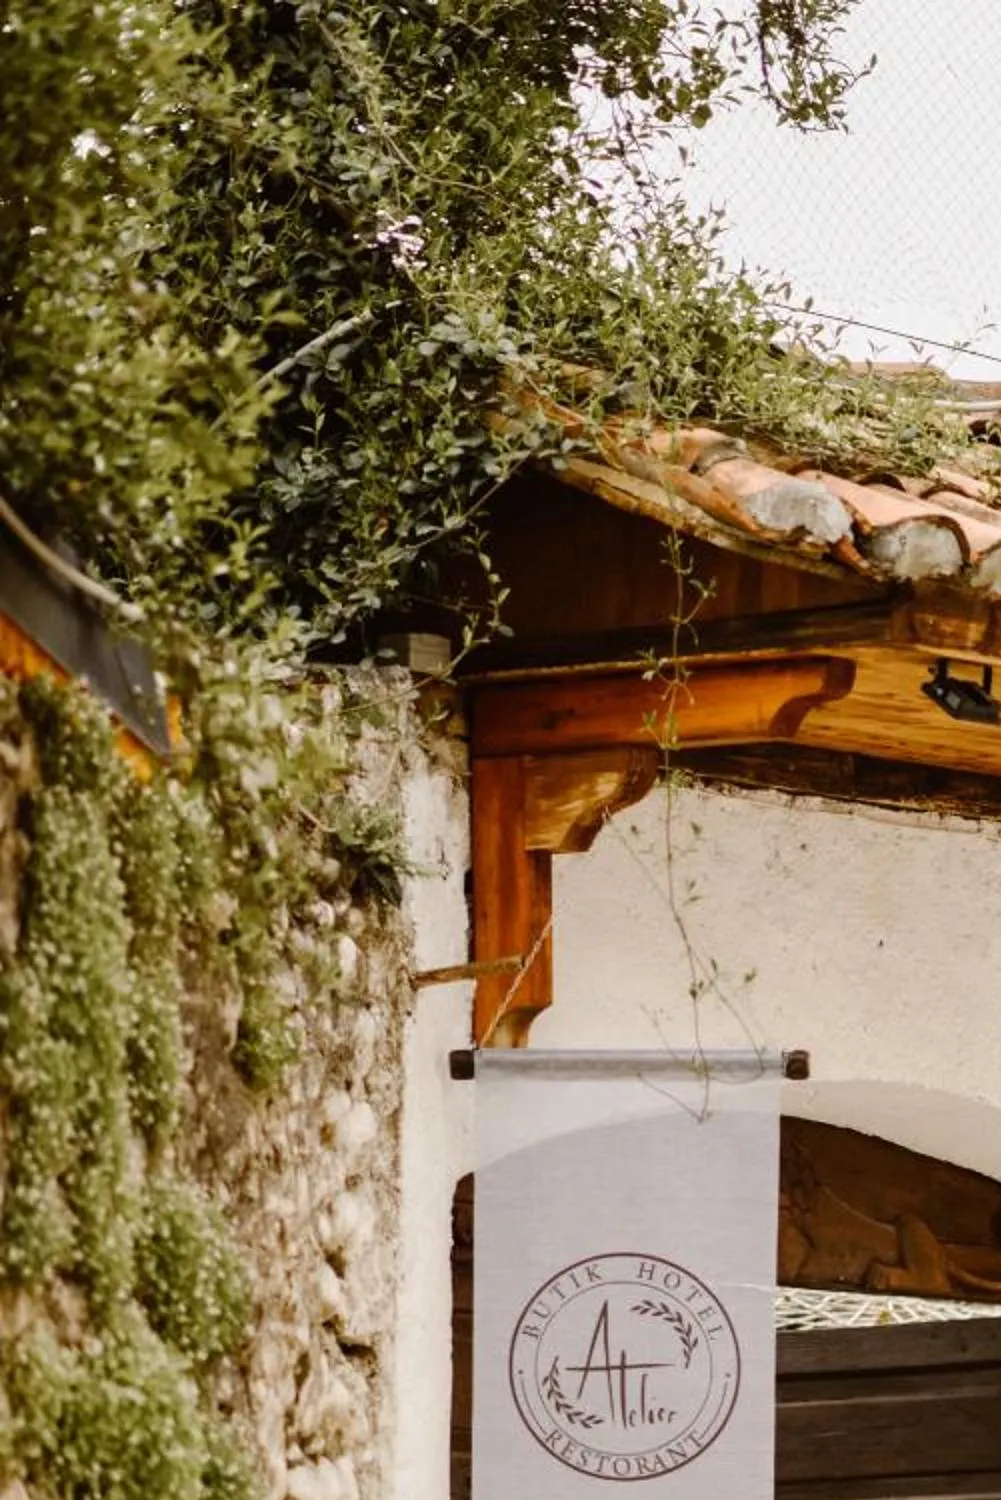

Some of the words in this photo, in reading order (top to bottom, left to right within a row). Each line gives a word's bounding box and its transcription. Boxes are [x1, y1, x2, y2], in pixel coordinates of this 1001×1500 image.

[522, 1263, 602, 1340] BUTIK
[636, 1261, 724, 1342] HOTEL
[545, 1429, 703, 1477] RESTORANT
